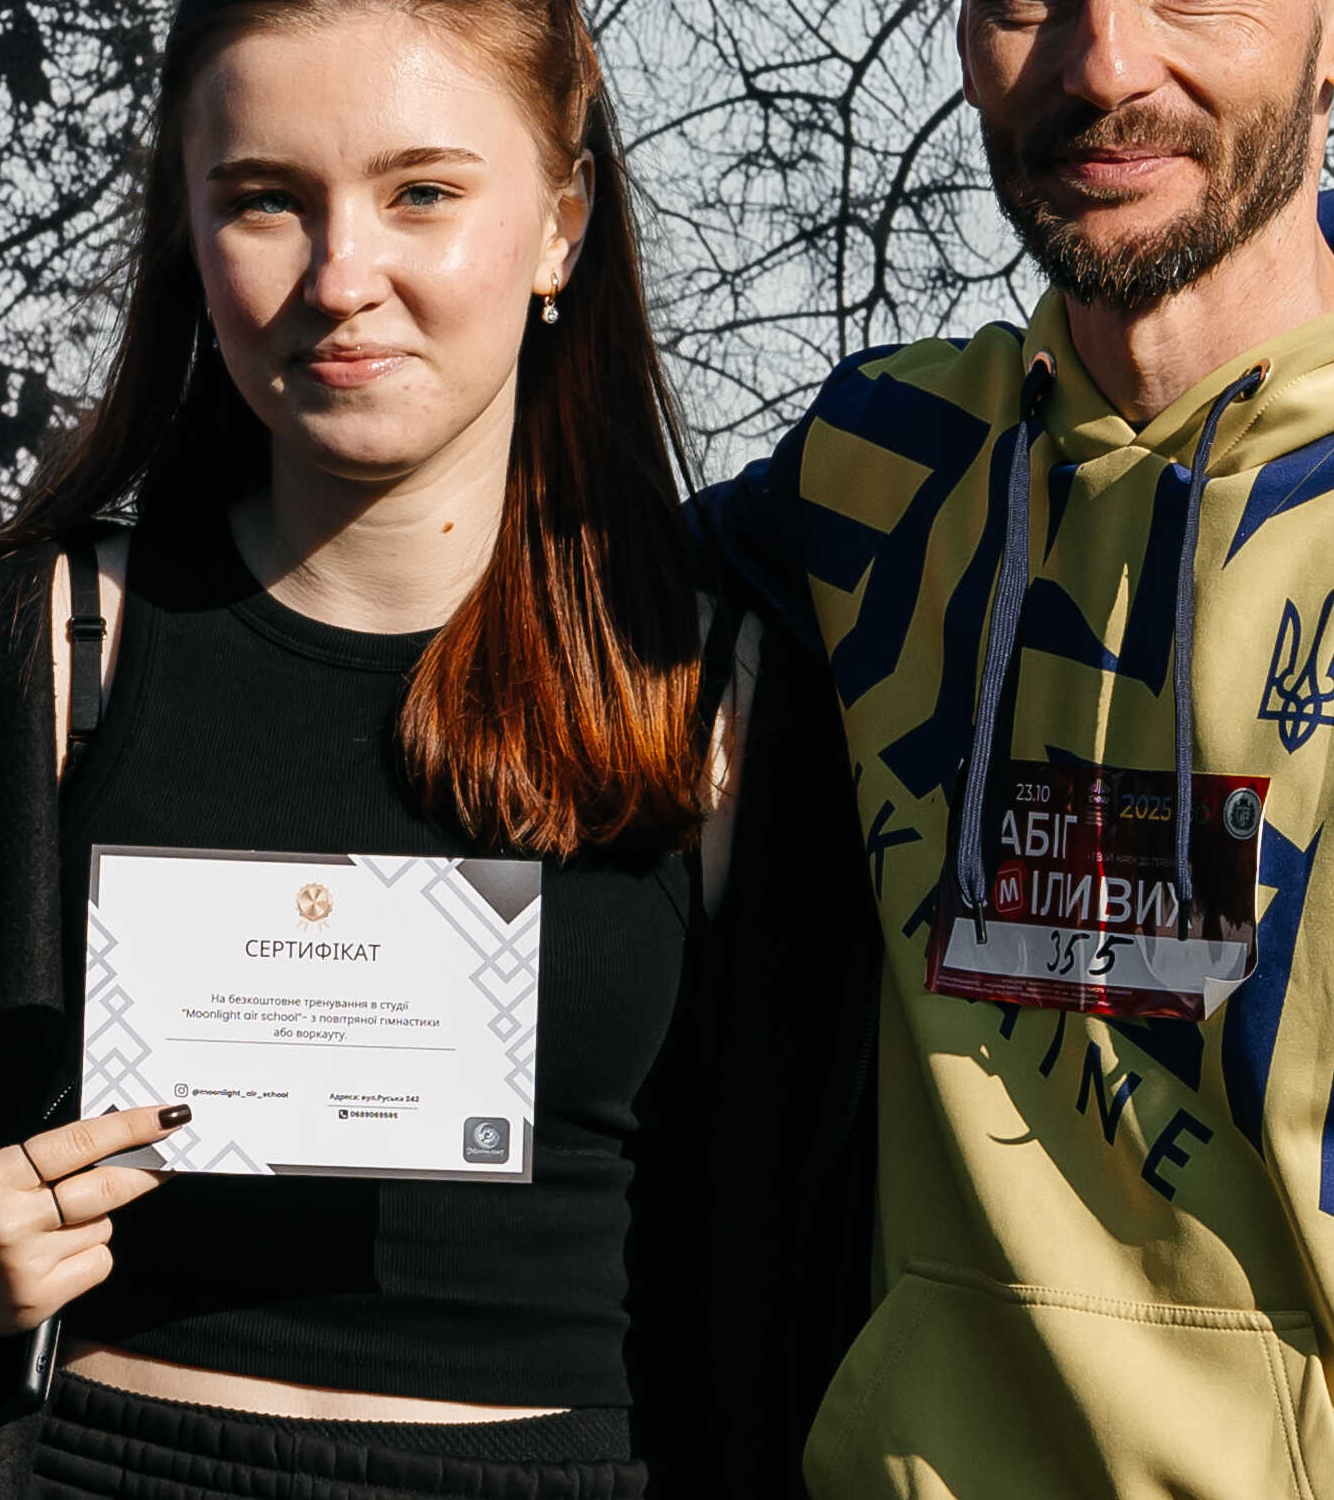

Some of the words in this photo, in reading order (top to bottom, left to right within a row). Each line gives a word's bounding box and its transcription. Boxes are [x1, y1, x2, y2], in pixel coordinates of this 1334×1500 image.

[1017, 783, 1050, 803] 23.10
[1120, 794, 1172, 821] 2025
[245, 938, 381, 963] СЕРТИФІКАТ
[211, 993, 226, 1005] На
[228, 993, 302, 1008] безкоштовне
[304, 998, 369, 1011] тренування
[379, 1001, 410, 1013] студії
[243, 1011, 259, 1021] air
[318, 1013, 379, 1027] повітряної
[379, 1016, 441, 1028] гімнастики
[272, 1027, 294, 1038] або
